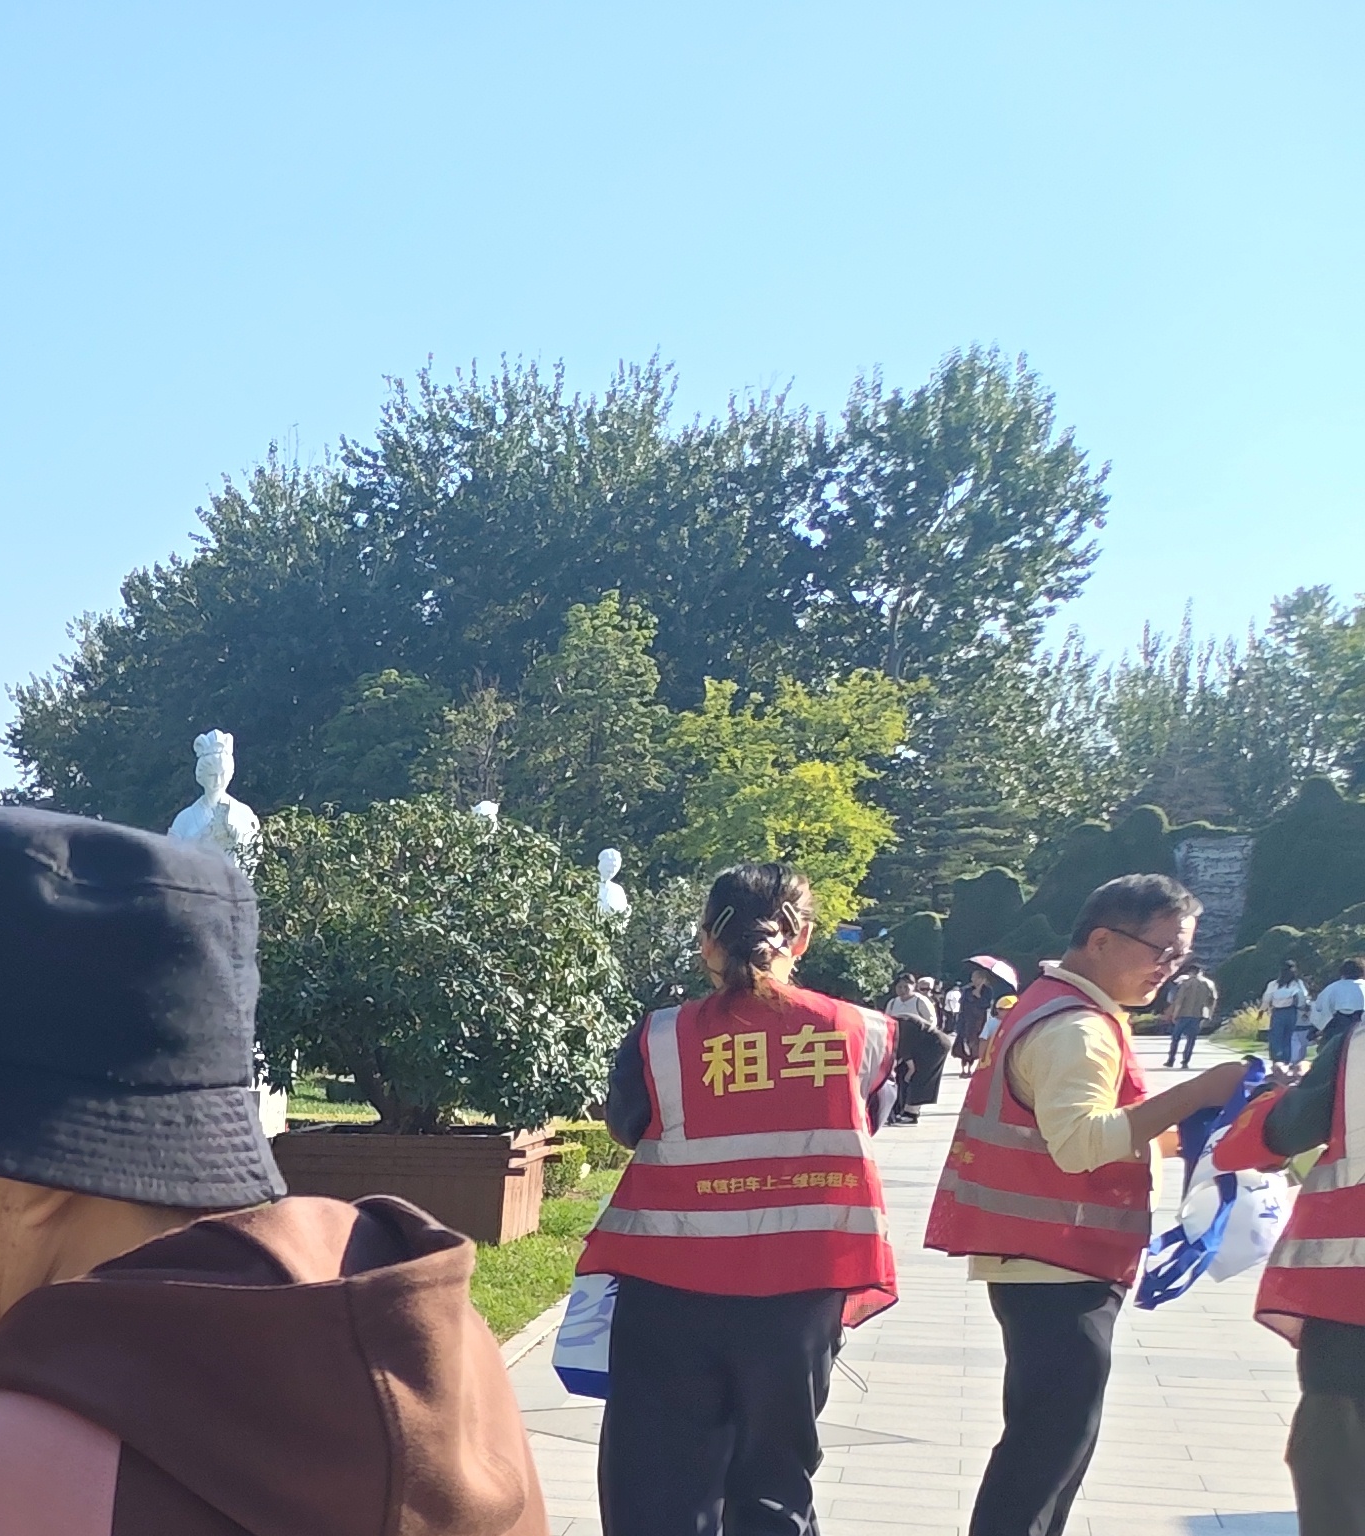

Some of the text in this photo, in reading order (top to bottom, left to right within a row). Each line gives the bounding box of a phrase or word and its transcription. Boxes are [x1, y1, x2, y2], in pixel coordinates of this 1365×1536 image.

[701, 1024, 849, 1097] 租车
[696, 1172, 860, 1195] 微信扫车上二维码租车
